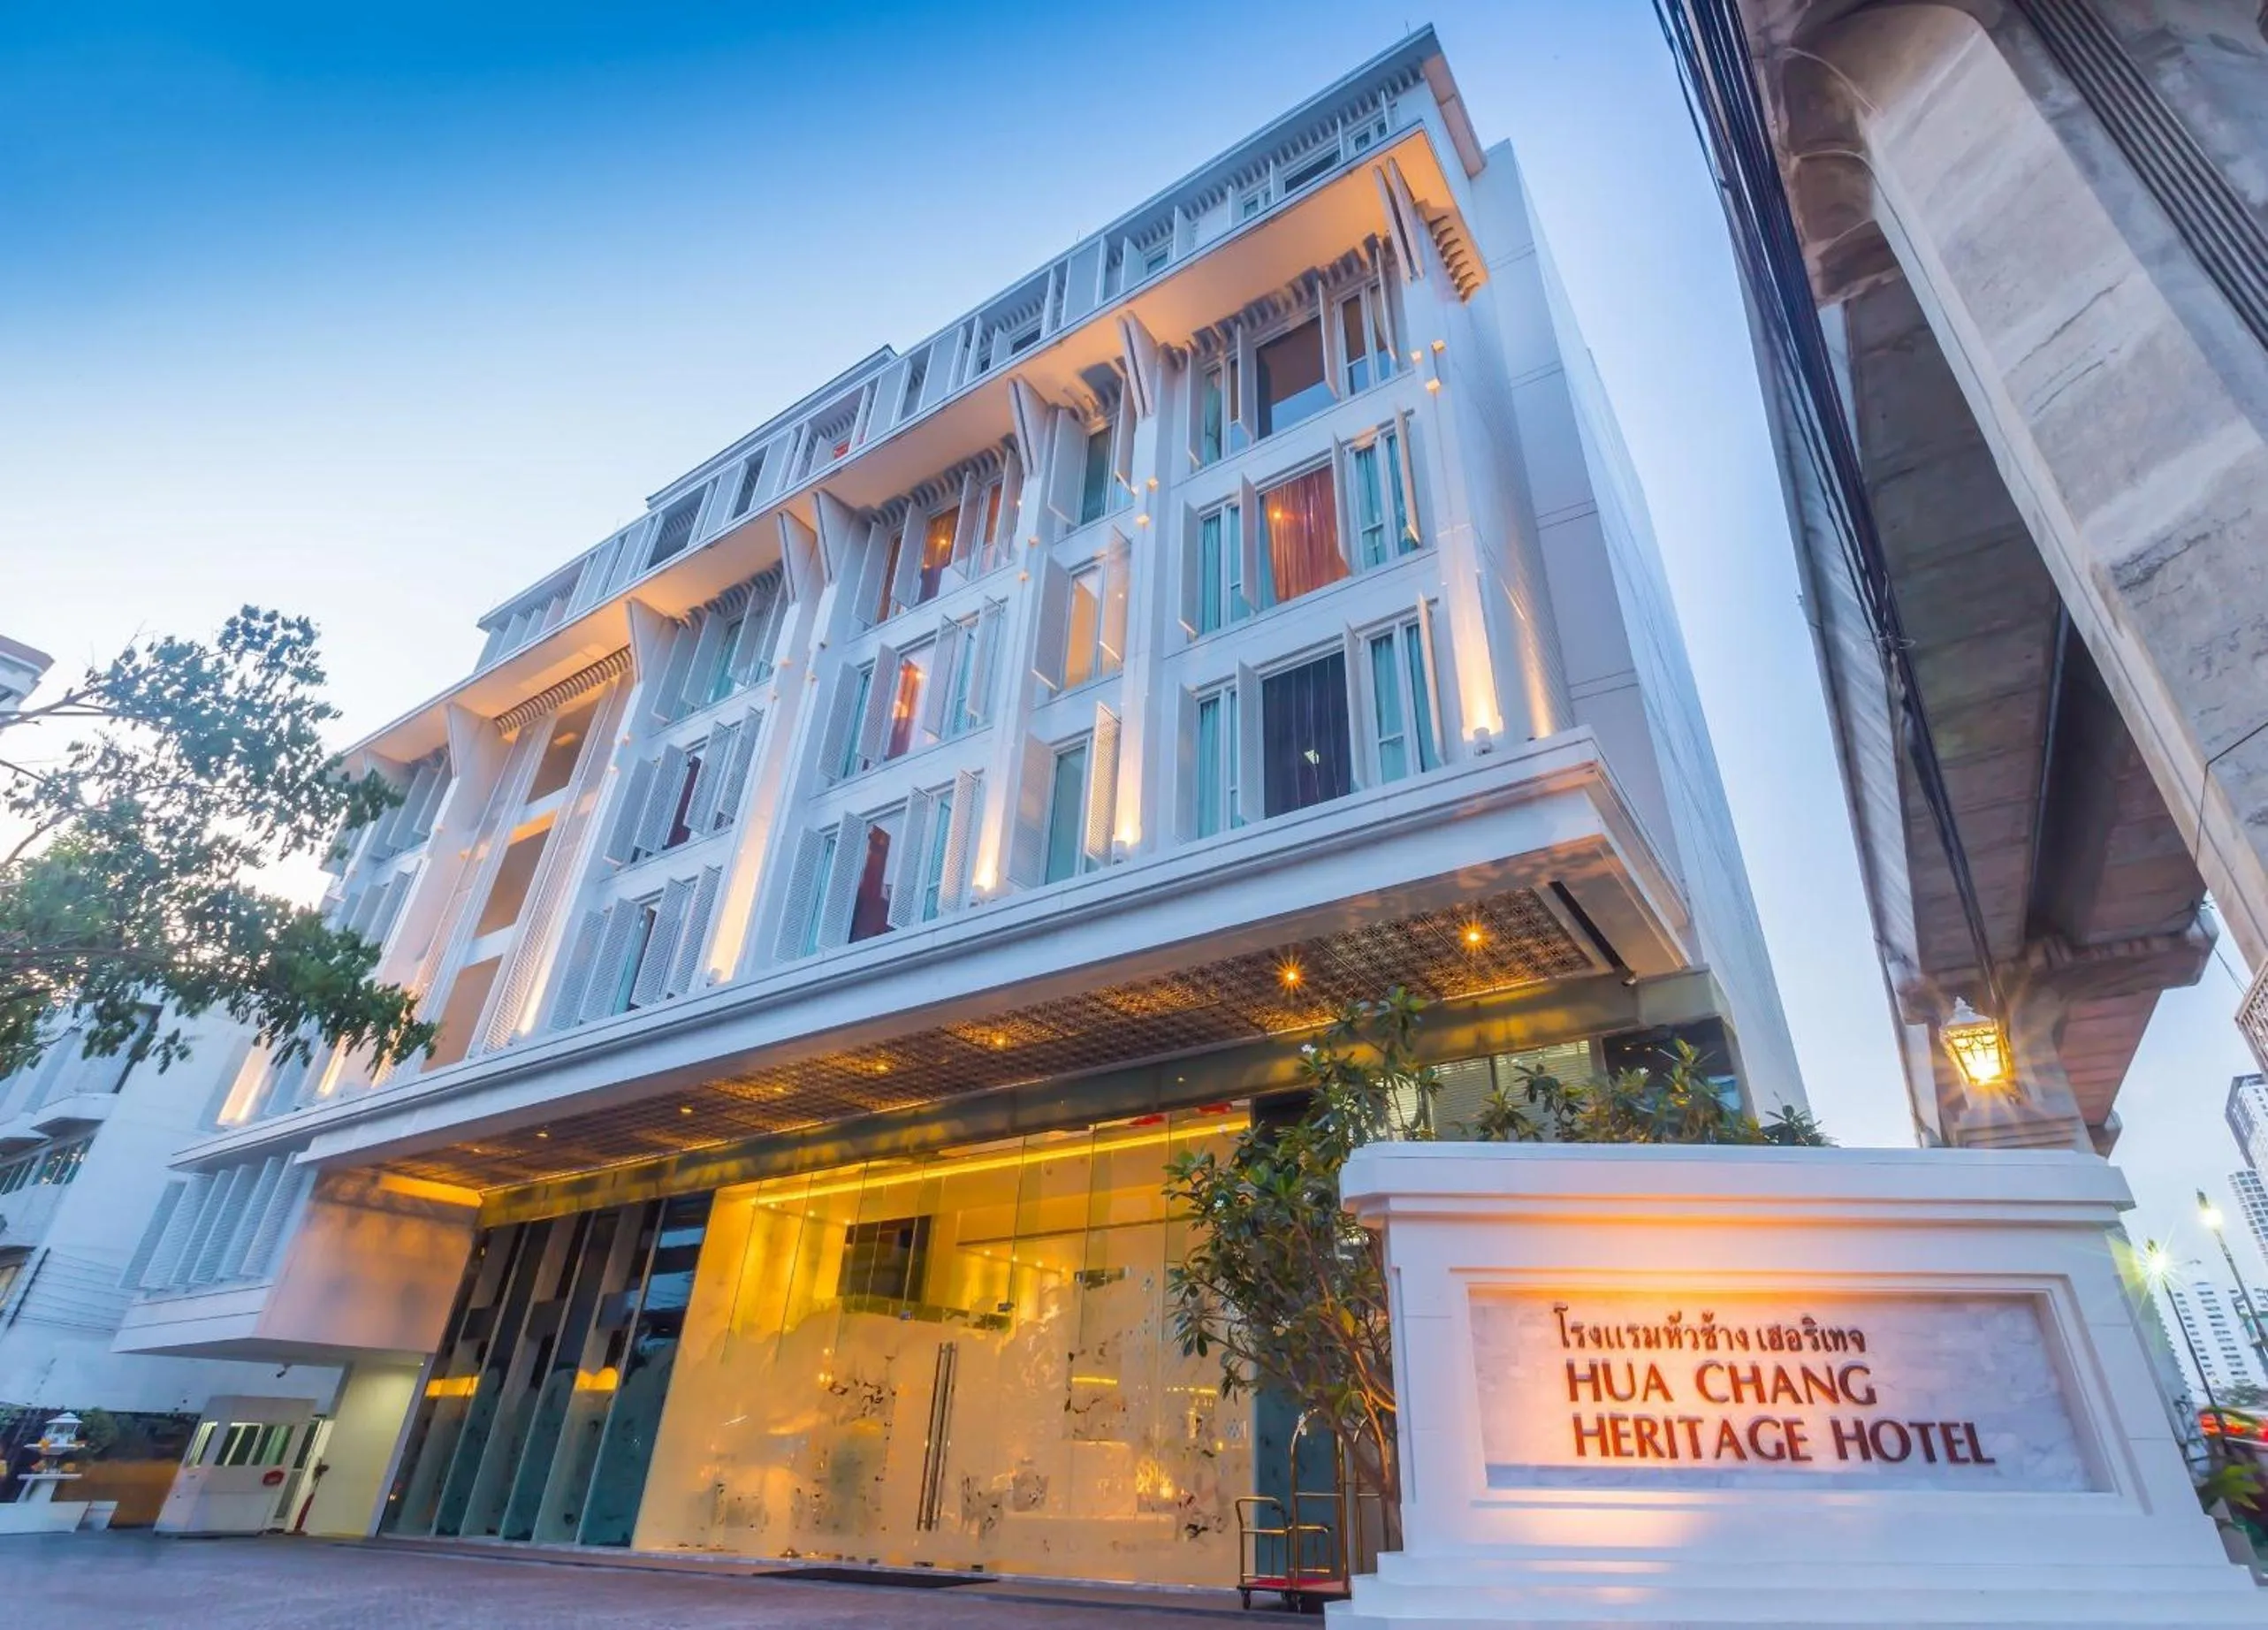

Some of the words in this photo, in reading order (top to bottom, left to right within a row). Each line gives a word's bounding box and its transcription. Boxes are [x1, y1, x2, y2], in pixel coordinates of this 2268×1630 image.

[1554, 1302, 1750, 1352] โรงแรมหัวช้าง
[1756, 1314, 1867, 1354] เฮอริเทจ
[1566, 1359, 1674, 1403] HUA
[1695, 1359, 1877, 1405] CHANG
[1572, 1413, 1813, 1461] HERITAGE
[1830, 1415, 1997, 1465] HOTEL
